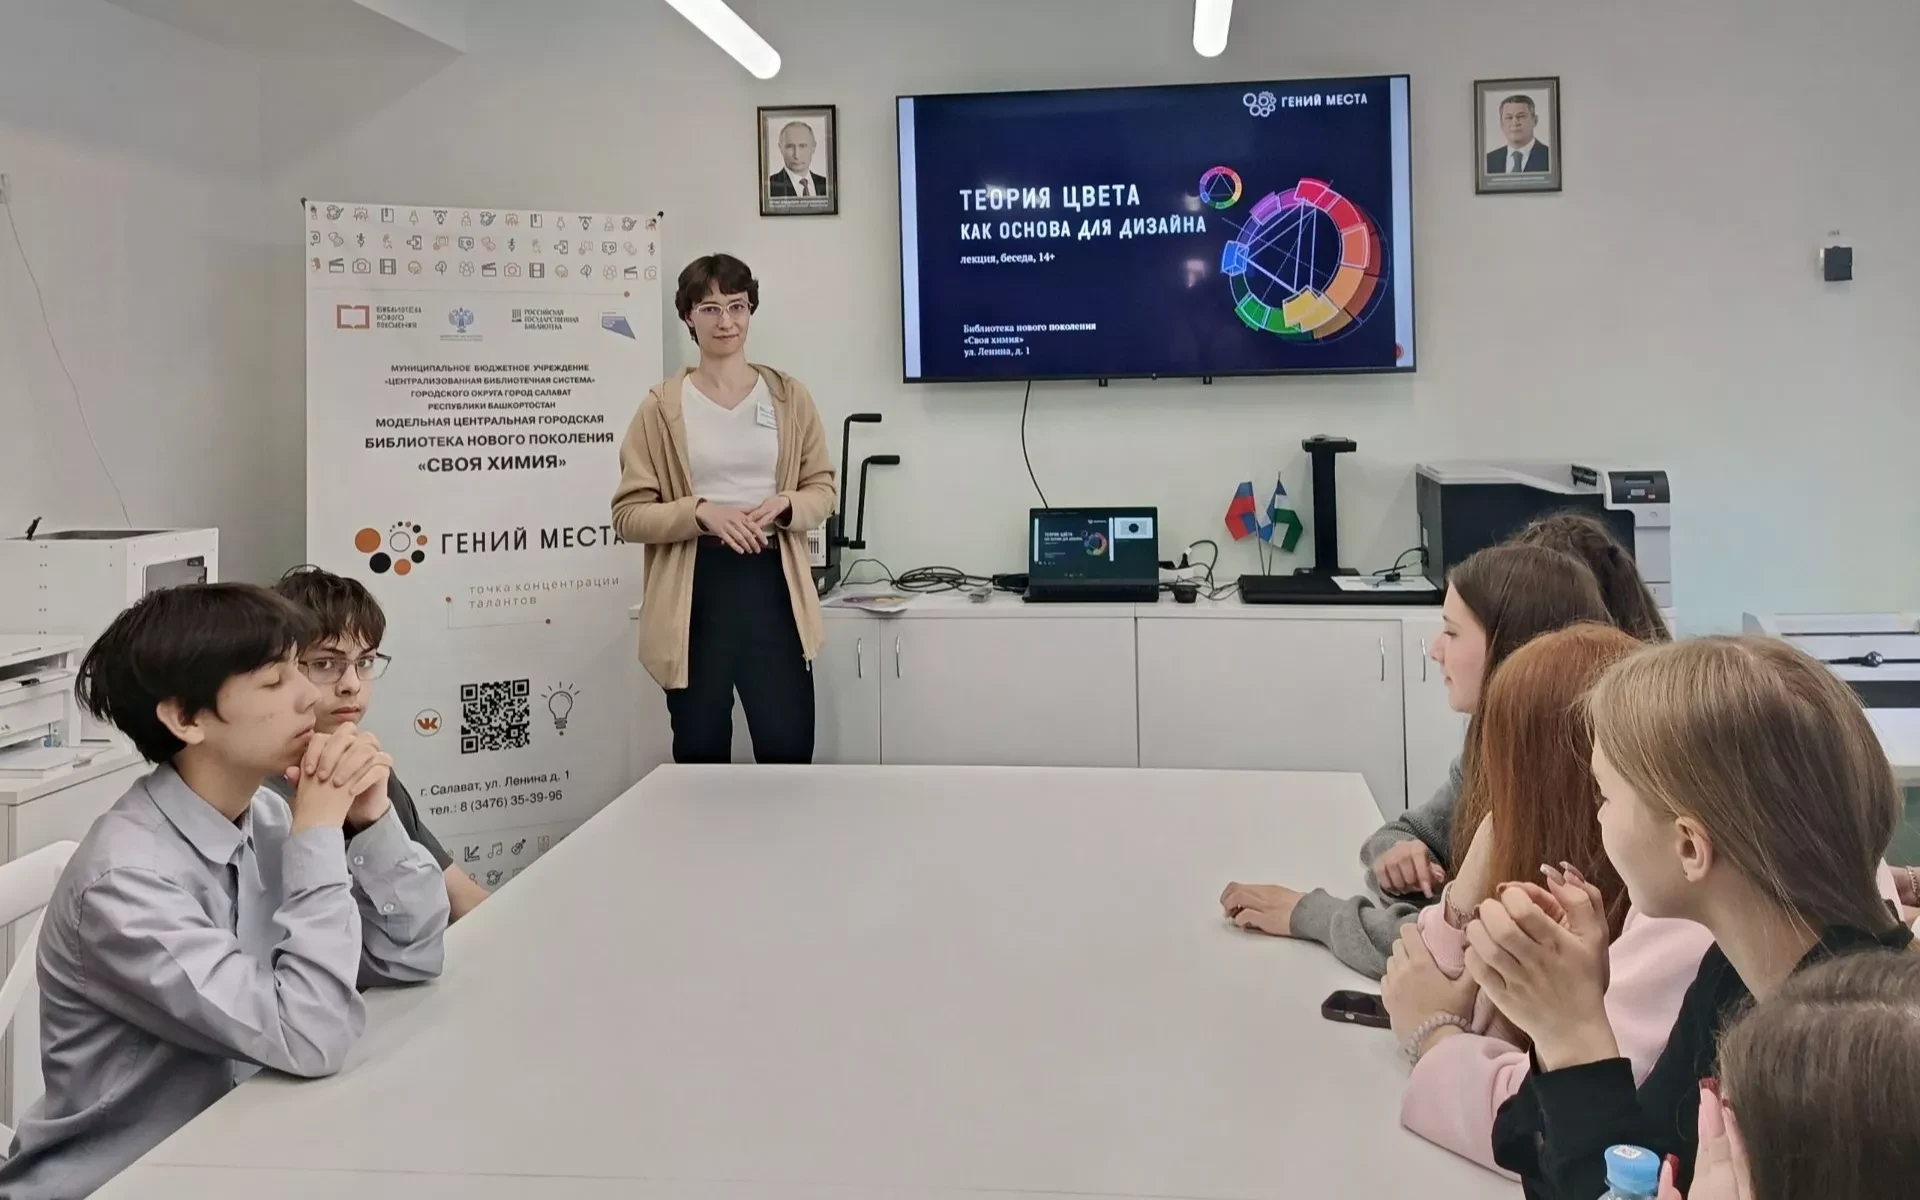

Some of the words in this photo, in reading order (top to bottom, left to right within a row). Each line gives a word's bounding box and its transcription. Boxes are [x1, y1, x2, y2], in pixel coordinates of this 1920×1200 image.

[1281, 93, 1321, 107] ГЕНИЙ
[1326, 93, 1368, 105] МЕСТА
[959, 187, 1050, 211] ТЕОРИЯ
[1063, 184, 1140, 212] ЦВЕТА
[960, 223, 992, 240] КАК
[999, 220, 1071, 239] ОСНОВА
[1078, 218, 1112, 240] ДЛЯ
[1119, 214, 1206, 239] ДИЗАЙНА
[960, 255, 999, 265] лекция,
[1000, 253, 1036, 264] беседа,
[1038, 252, 1055, 262] 14+
[963, 324, 1014, 333] Библиотека
[1016, 325, 1047, 333] нового
[1049, 323, 1096, 331] поколения
[964, 336, 989, 345] «Своя
[991, 336, 1024, 345] химия»
[964, 348, 976, 358] ул.
[978, 347, 1014, 357] Ленина,
[1015, 348, 1023, 356] д.
[1026, 346, 1030, 355] 1
[391, 364, 471, 373] МУНИЦИПАЛЬНОЕ
[474, 364, 530, 373] БЮДЖЕТНОЕ
[533, 364, 590, 372] УЧРЕЖДЕНИЕ
[484, 376, 551, 385] БИБЛИОТЕЧНАЯ
[411, 389, 469, 398] ГОРОДСКОГО
[471, 389, 503, 397] ОКРУГА
[504, 389, 533, 397] ГОРОД
[534, 388, 571, 397] САЛАВАТ
[428, 402, 486, 411] РЕСПУБЛИКИ
[487, 401, 556, 410] БАШКОРТОСТАН
[375, 417, 451, 429] МОДЕЛЬНАЯ
[453, 416, 536, 427] ЦЕНТРАЛЬНАЯ
[538, 414, 604, 426] ГОРОДСКАЯ
[365, 436, 464, 449] БИБЛИОТЕКА
[467, 434, 525, 446] НОВОГО
[529, 432, 614, 445] ПОКОЛЕНИЯ
[418, 456, 482, 473] «СВОЯ
[487, 454, 566, 471] ХИМИЯ»
[442, 526, 527, 554] ГЕНИЙ
[469, 585, 511, 595] точка
[515, 576, 619, 592] концентрации
[470, 597, 537, 609] талантов
[420, 789, 428, 797] г.
[430, 782, 482, 796] Салават,
[485, 779, 501, 791] ул.
[505, 774, 547, 787] Ленина
[550, 773, 560, 783] д.
[565, 770, 570, 780] 1
[429, 804, 457, 815] тел.:
[460, 801, 468, 812] 8
[471, 797, 508, 813] (3476)
[510, 790, 563, 806] 35-39-96
